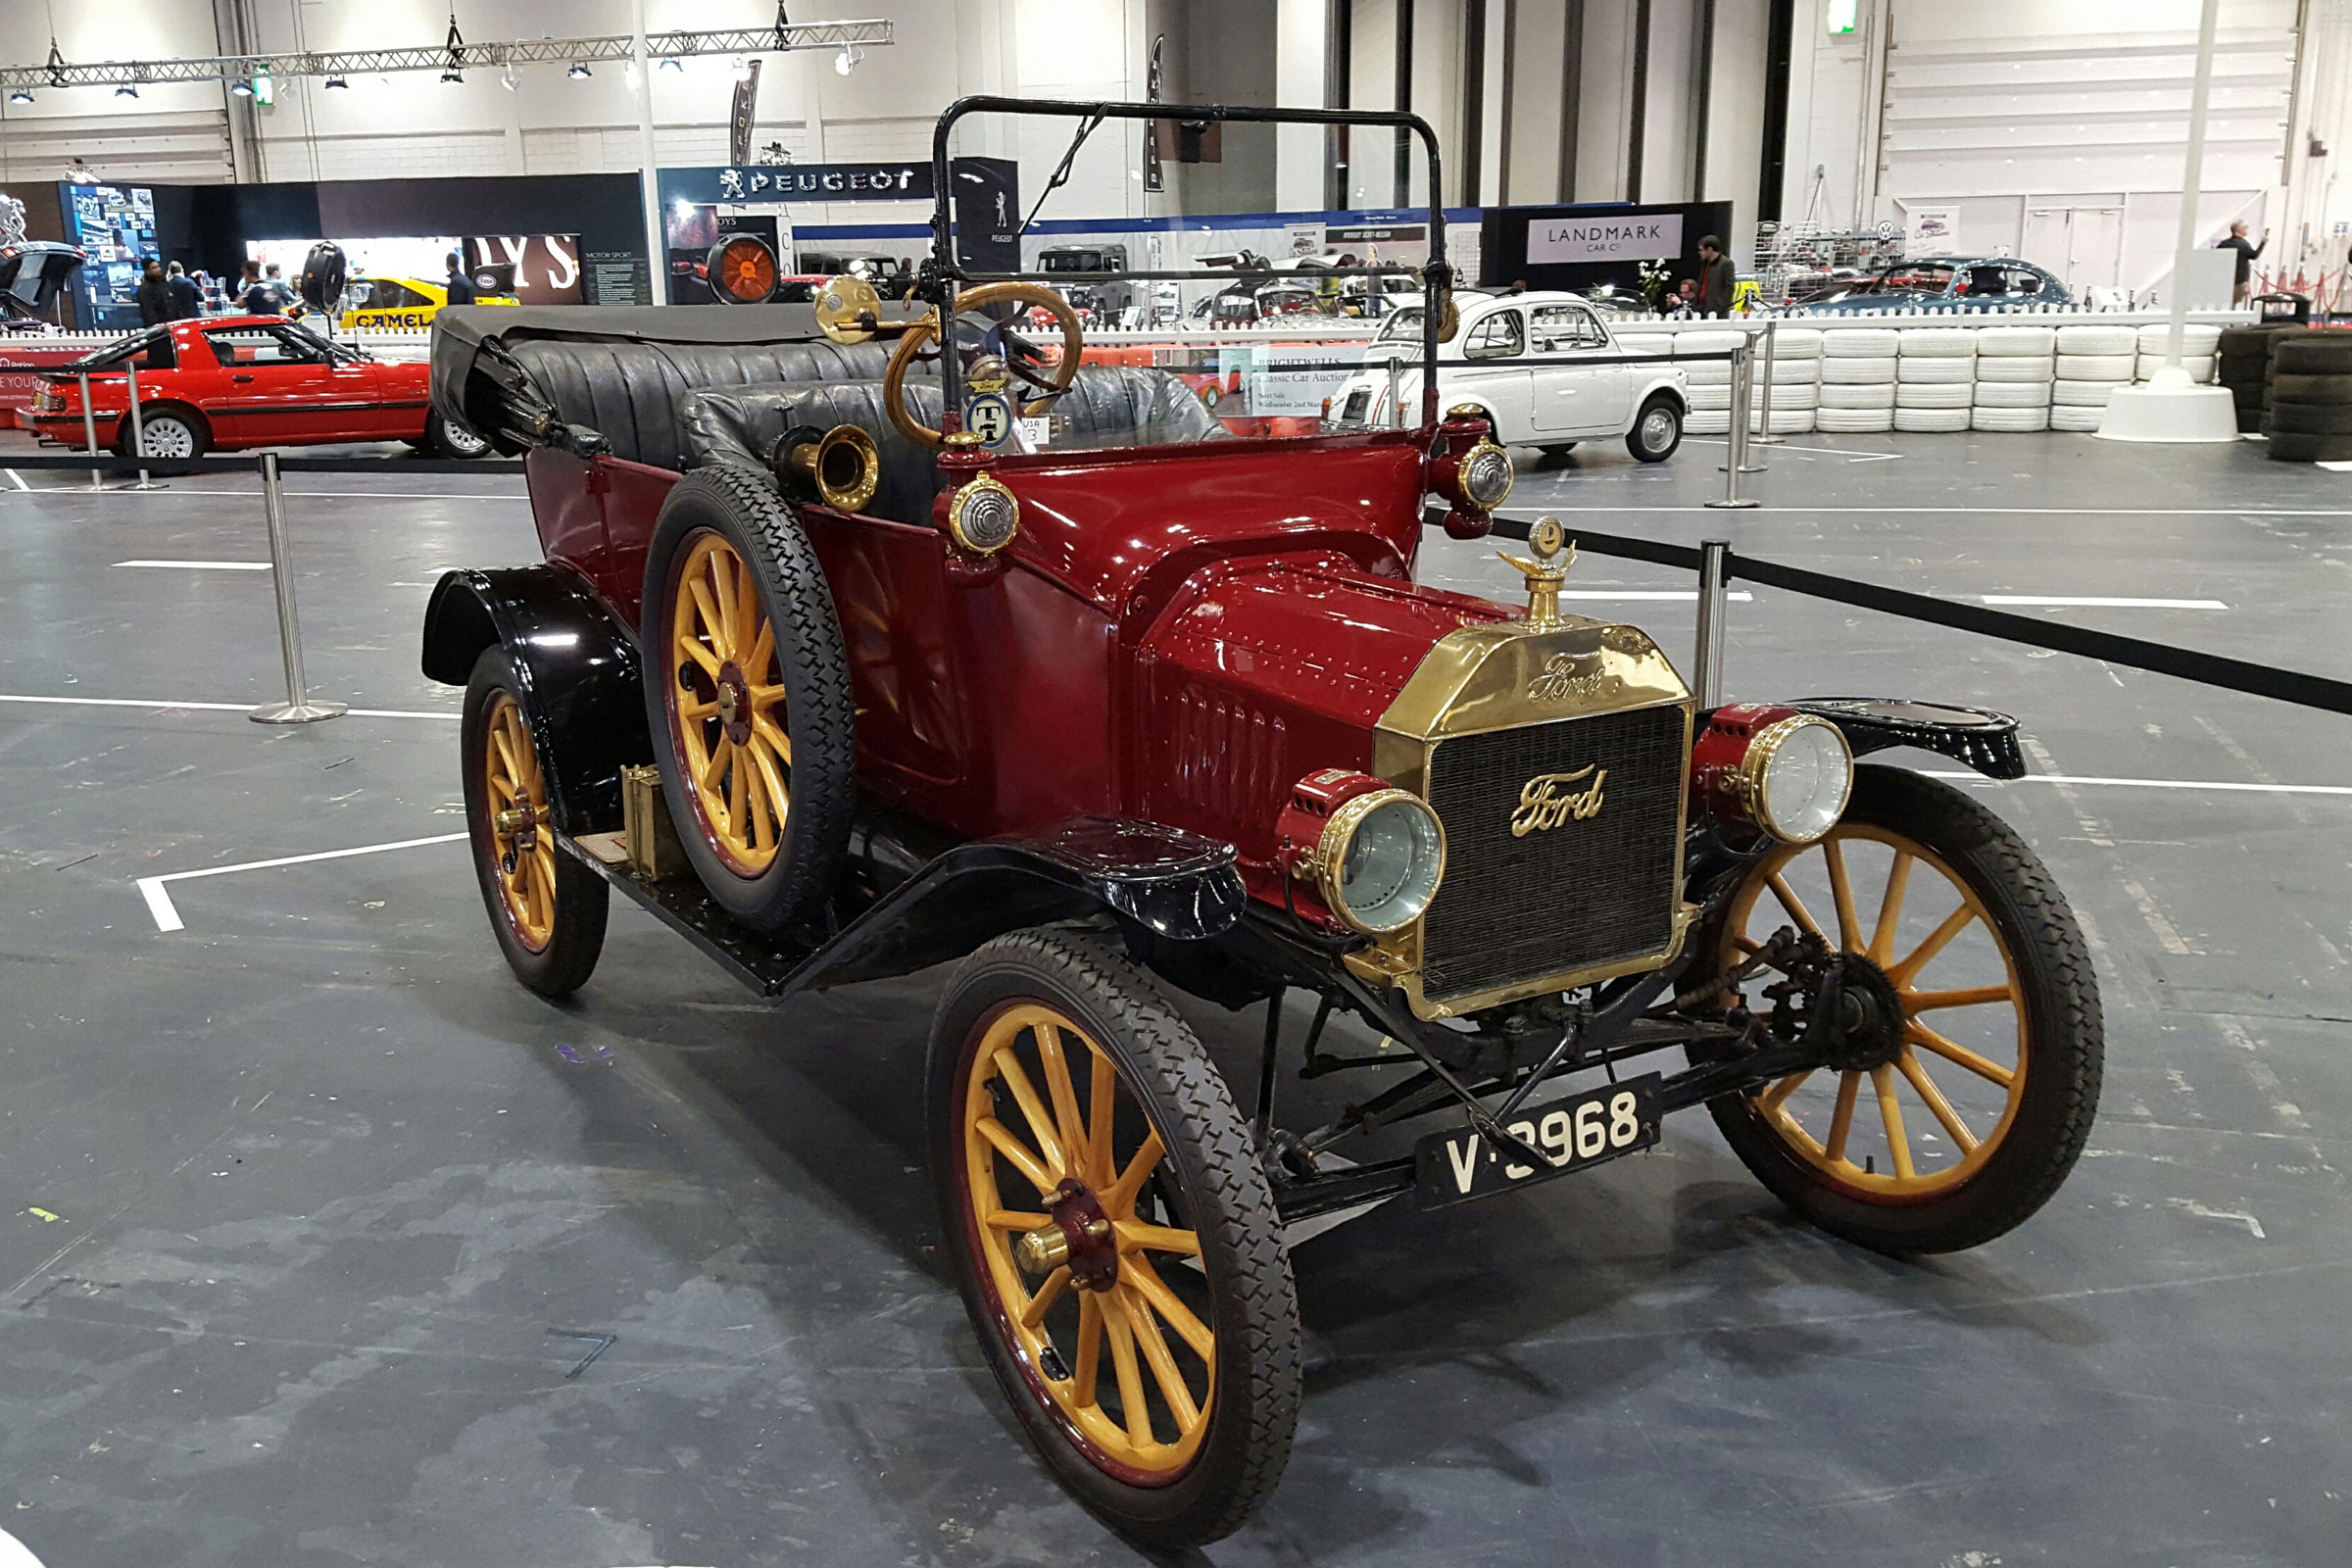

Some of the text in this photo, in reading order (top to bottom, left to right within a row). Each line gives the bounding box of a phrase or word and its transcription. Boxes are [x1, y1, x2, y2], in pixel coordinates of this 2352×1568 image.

[751, 171, 914, 192] PEUGEOT
[1548, 225, 1660, 242] LANDMARK
[356, 314, 433, 329] CAMEL
[1258, 372, 1291, 382] Classic
[1292, 372, 1309, 382] Car
[1027, 429, 1038, 441] 3
[1528, 651, 1606, 703] Ford
[1510, 763, 1608, 838] Ford
